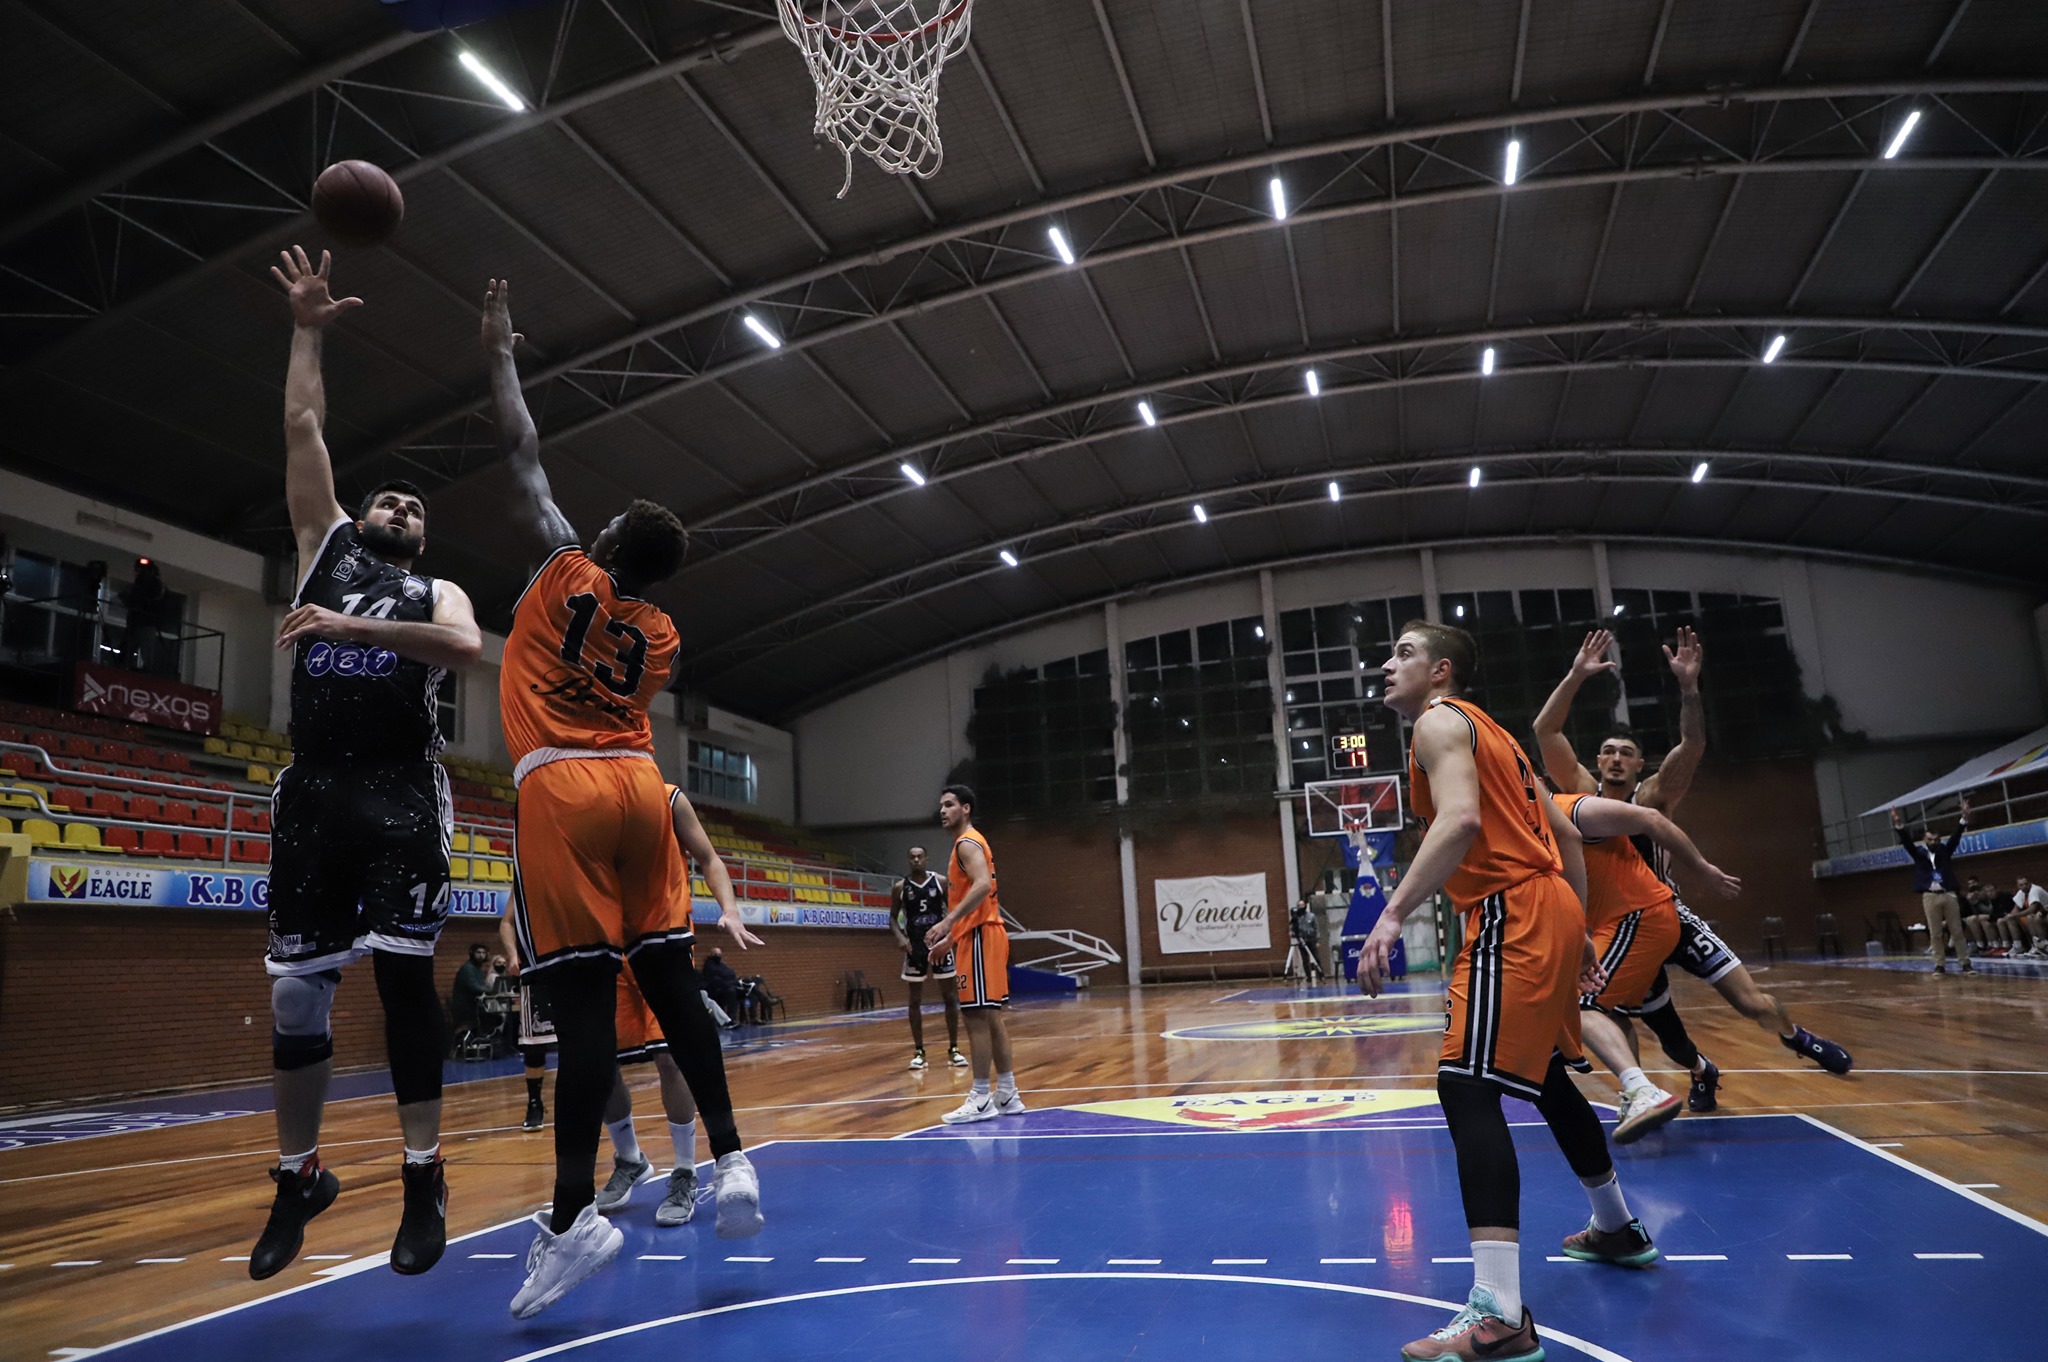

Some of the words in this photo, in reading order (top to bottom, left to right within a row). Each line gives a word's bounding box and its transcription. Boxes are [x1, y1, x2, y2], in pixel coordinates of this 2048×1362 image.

[342, 593, 397, 619] 14
[560, 591, 650, 699] 13
[107, 684, 210, 720] nexos
[1340, 734, 1366, 749] 3:00
[1351, 751, 1368, 767] 17
[94, 869, 151, 879] GOLDEN
[90, 878, 152, 899] EAGLE
[187, 876, 245, 905] K.B
[409, 882, 450, 919] 14
[452, 889, 498, 913] YLLI
[919, 899, 928, 912] 5
[819, 910, 851, 925] GOLDEN
[852, 912, 876, 925] EAGLE
[1160, 898, 1265, 932] Venecia
[946, 954, 952, 966] 5
